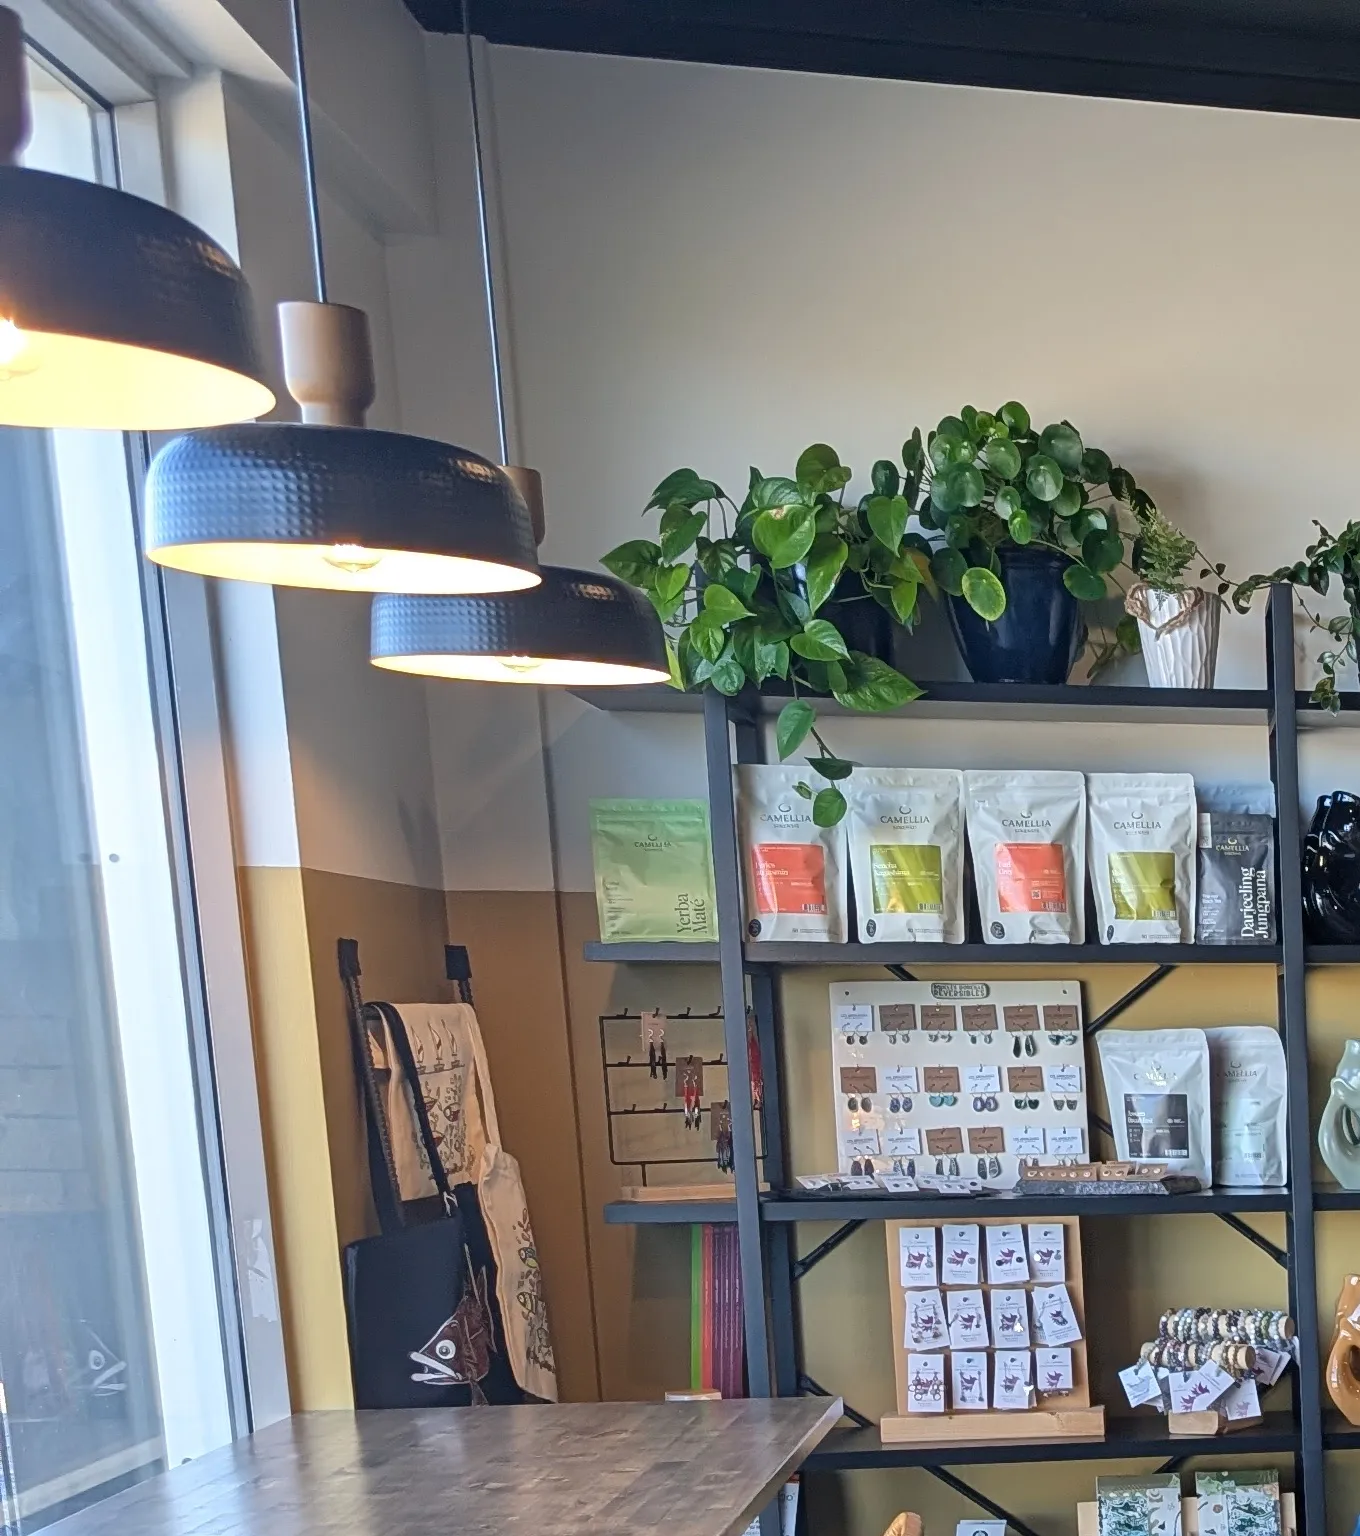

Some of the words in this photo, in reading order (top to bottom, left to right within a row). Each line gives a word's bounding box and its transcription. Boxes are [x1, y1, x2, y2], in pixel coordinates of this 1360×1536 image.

[760, 813, 812, 823] CAMELLIA
[880, 815, 930, 824] CAMELLIA
[1001, 819, 1052, 828] CAMELLIA
[1113, 821, 1162, 830] CAMELLIA
[1215, 844, 1250, 852] CAMELLIA
[1238, 866, 1256, 939] Darjeeling
[1255, 869, 1271, 939] Jungpana
[674, 893, 692, 934] Yerba
[690, 898, 708, 934] Maté
